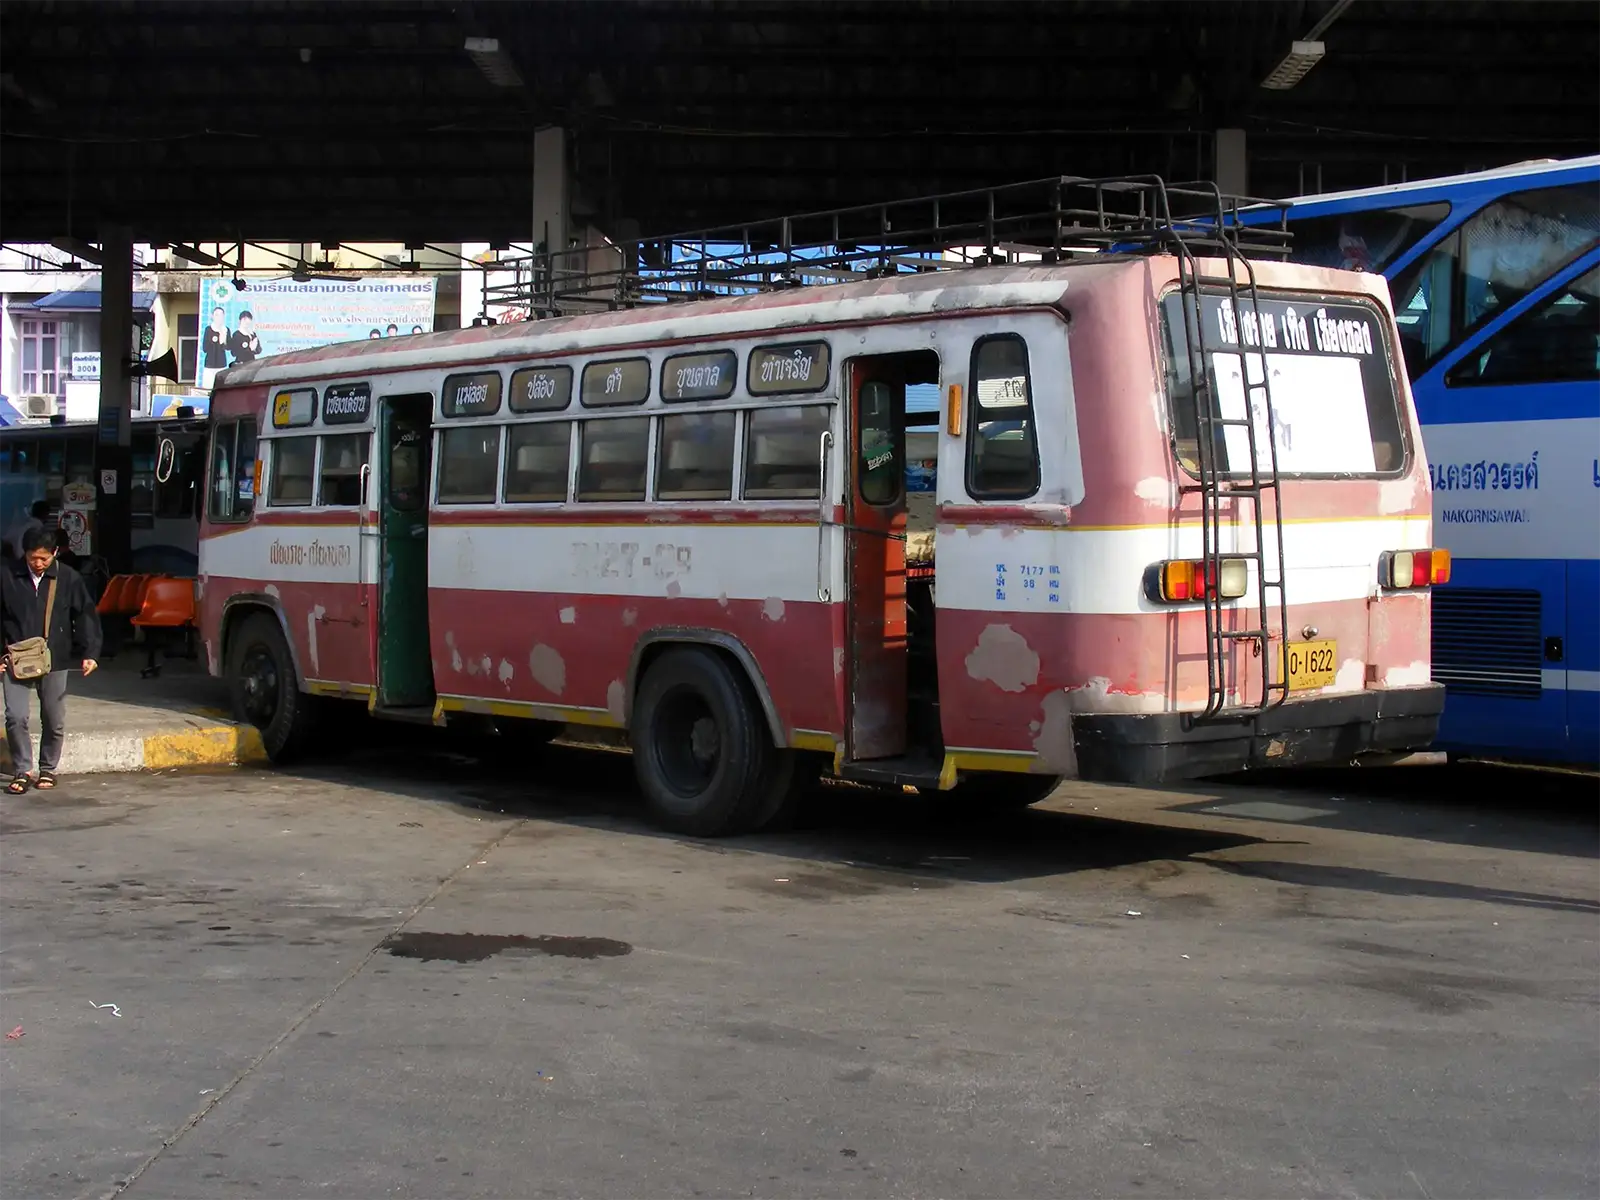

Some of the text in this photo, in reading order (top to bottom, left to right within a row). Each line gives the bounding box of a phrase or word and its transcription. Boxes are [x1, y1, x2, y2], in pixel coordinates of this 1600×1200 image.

[243, 281, 432, 293] รงเรียนสยามบริบาลศาสตร์
[1281, 306, 1310, 351] เทิง
[761, 349, 813, 382] ท่าเจริญ
[527, 374, 554, 400] ปล้อง
[676, 365, 721, 398] ขุนตาล
[1020, 565, 1044, 576] 7177
